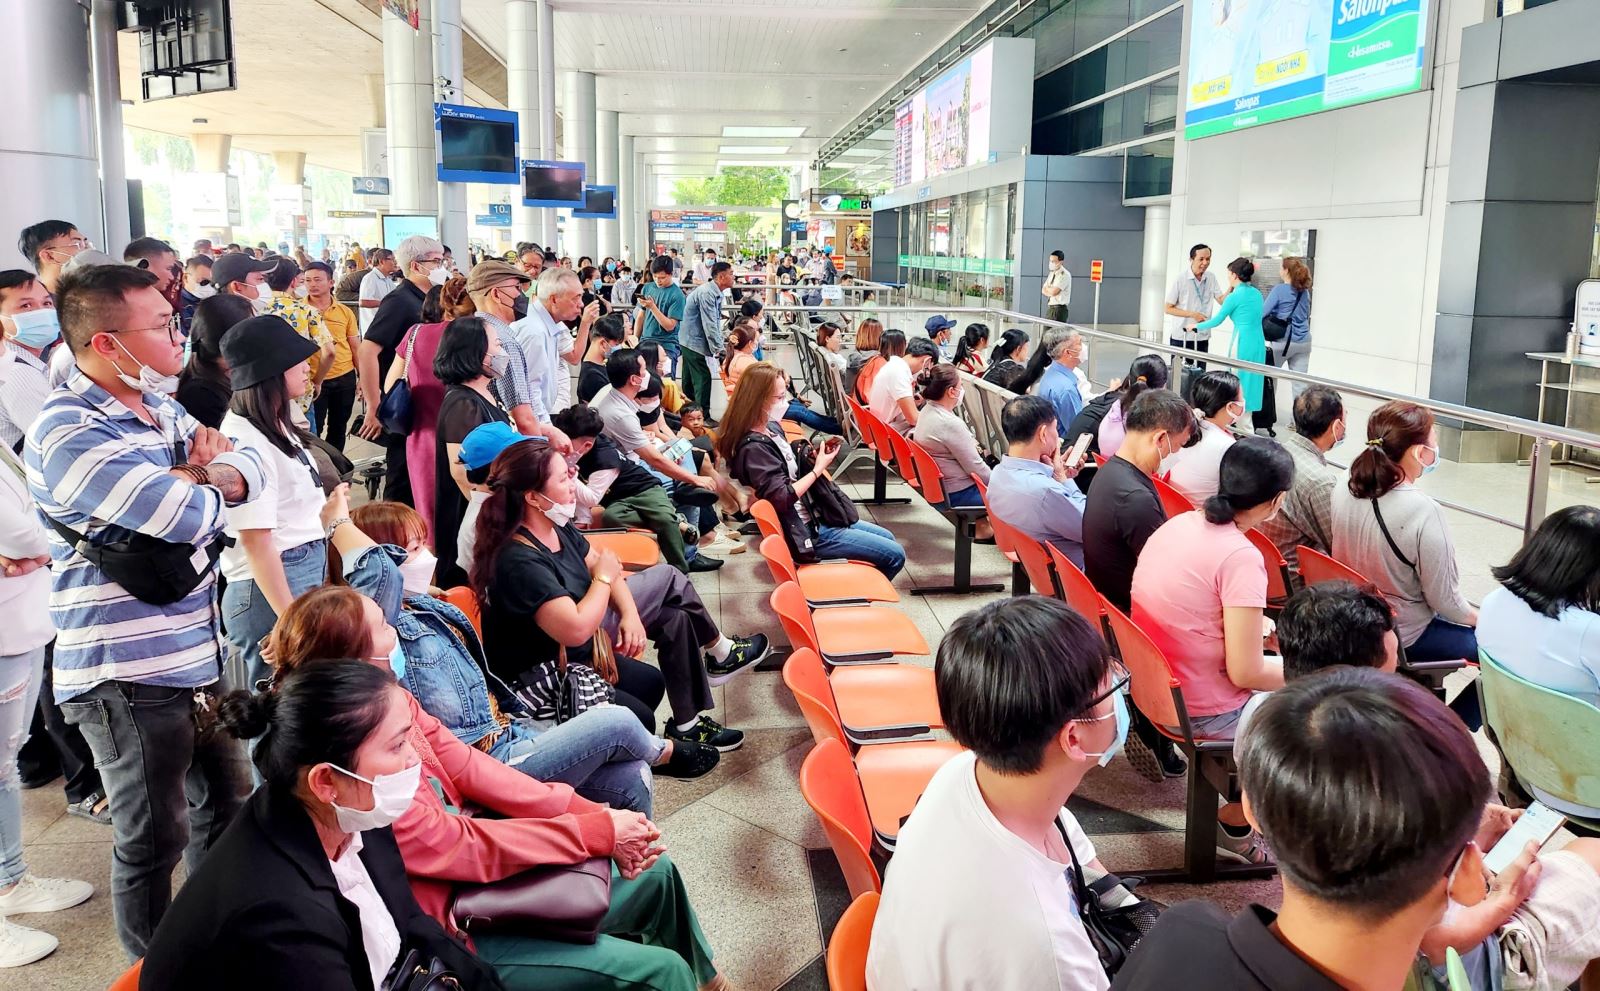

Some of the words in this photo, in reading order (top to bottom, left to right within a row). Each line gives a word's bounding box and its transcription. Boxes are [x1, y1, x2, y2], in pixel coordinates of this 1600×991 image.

[365, 179, 375, 192] 9
[493, 205, 505, 213] 10
[840, 199, 860, 209] BIG
